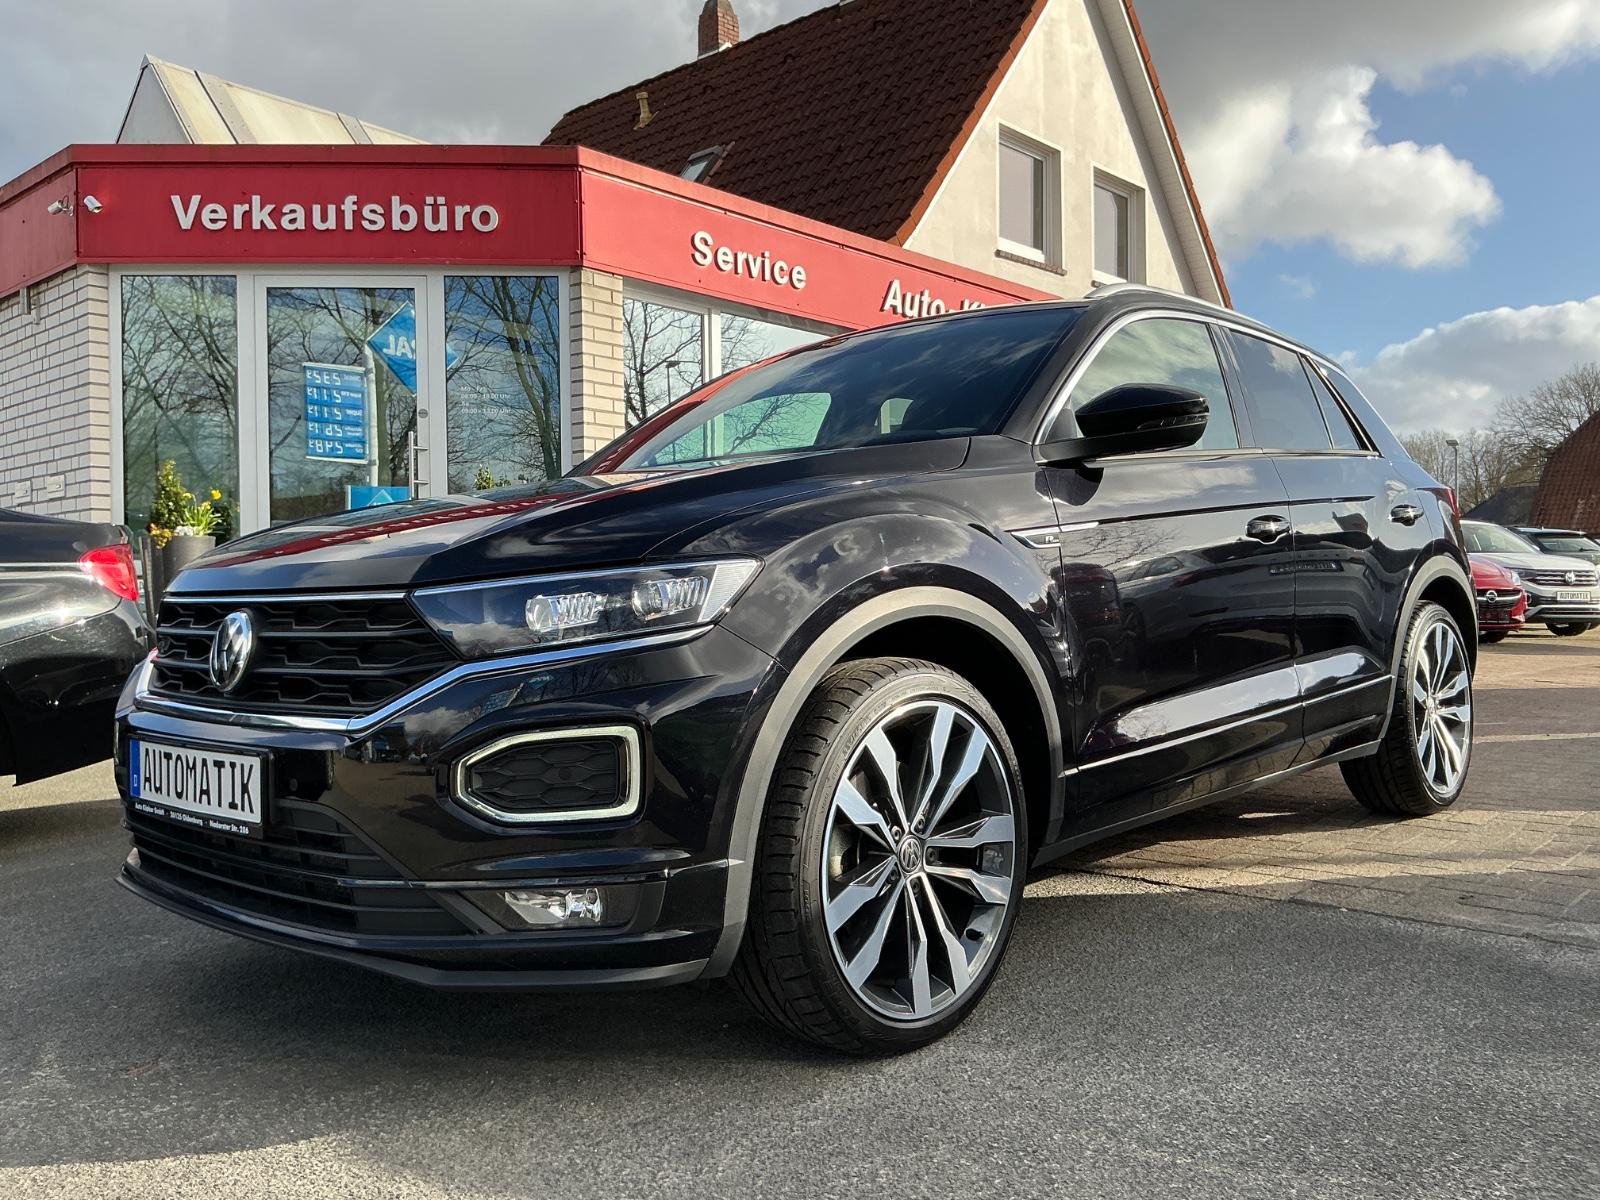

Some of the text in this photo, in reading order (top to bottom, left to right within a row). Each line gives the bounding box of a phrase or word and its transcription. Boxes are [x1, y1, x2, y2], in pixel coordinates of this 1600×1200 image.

[170, 194, 499, 233] Verkaufsbüro
[691, 230, 808, 290] Service
[143, 747, 255, 814] AUTOMATIK
